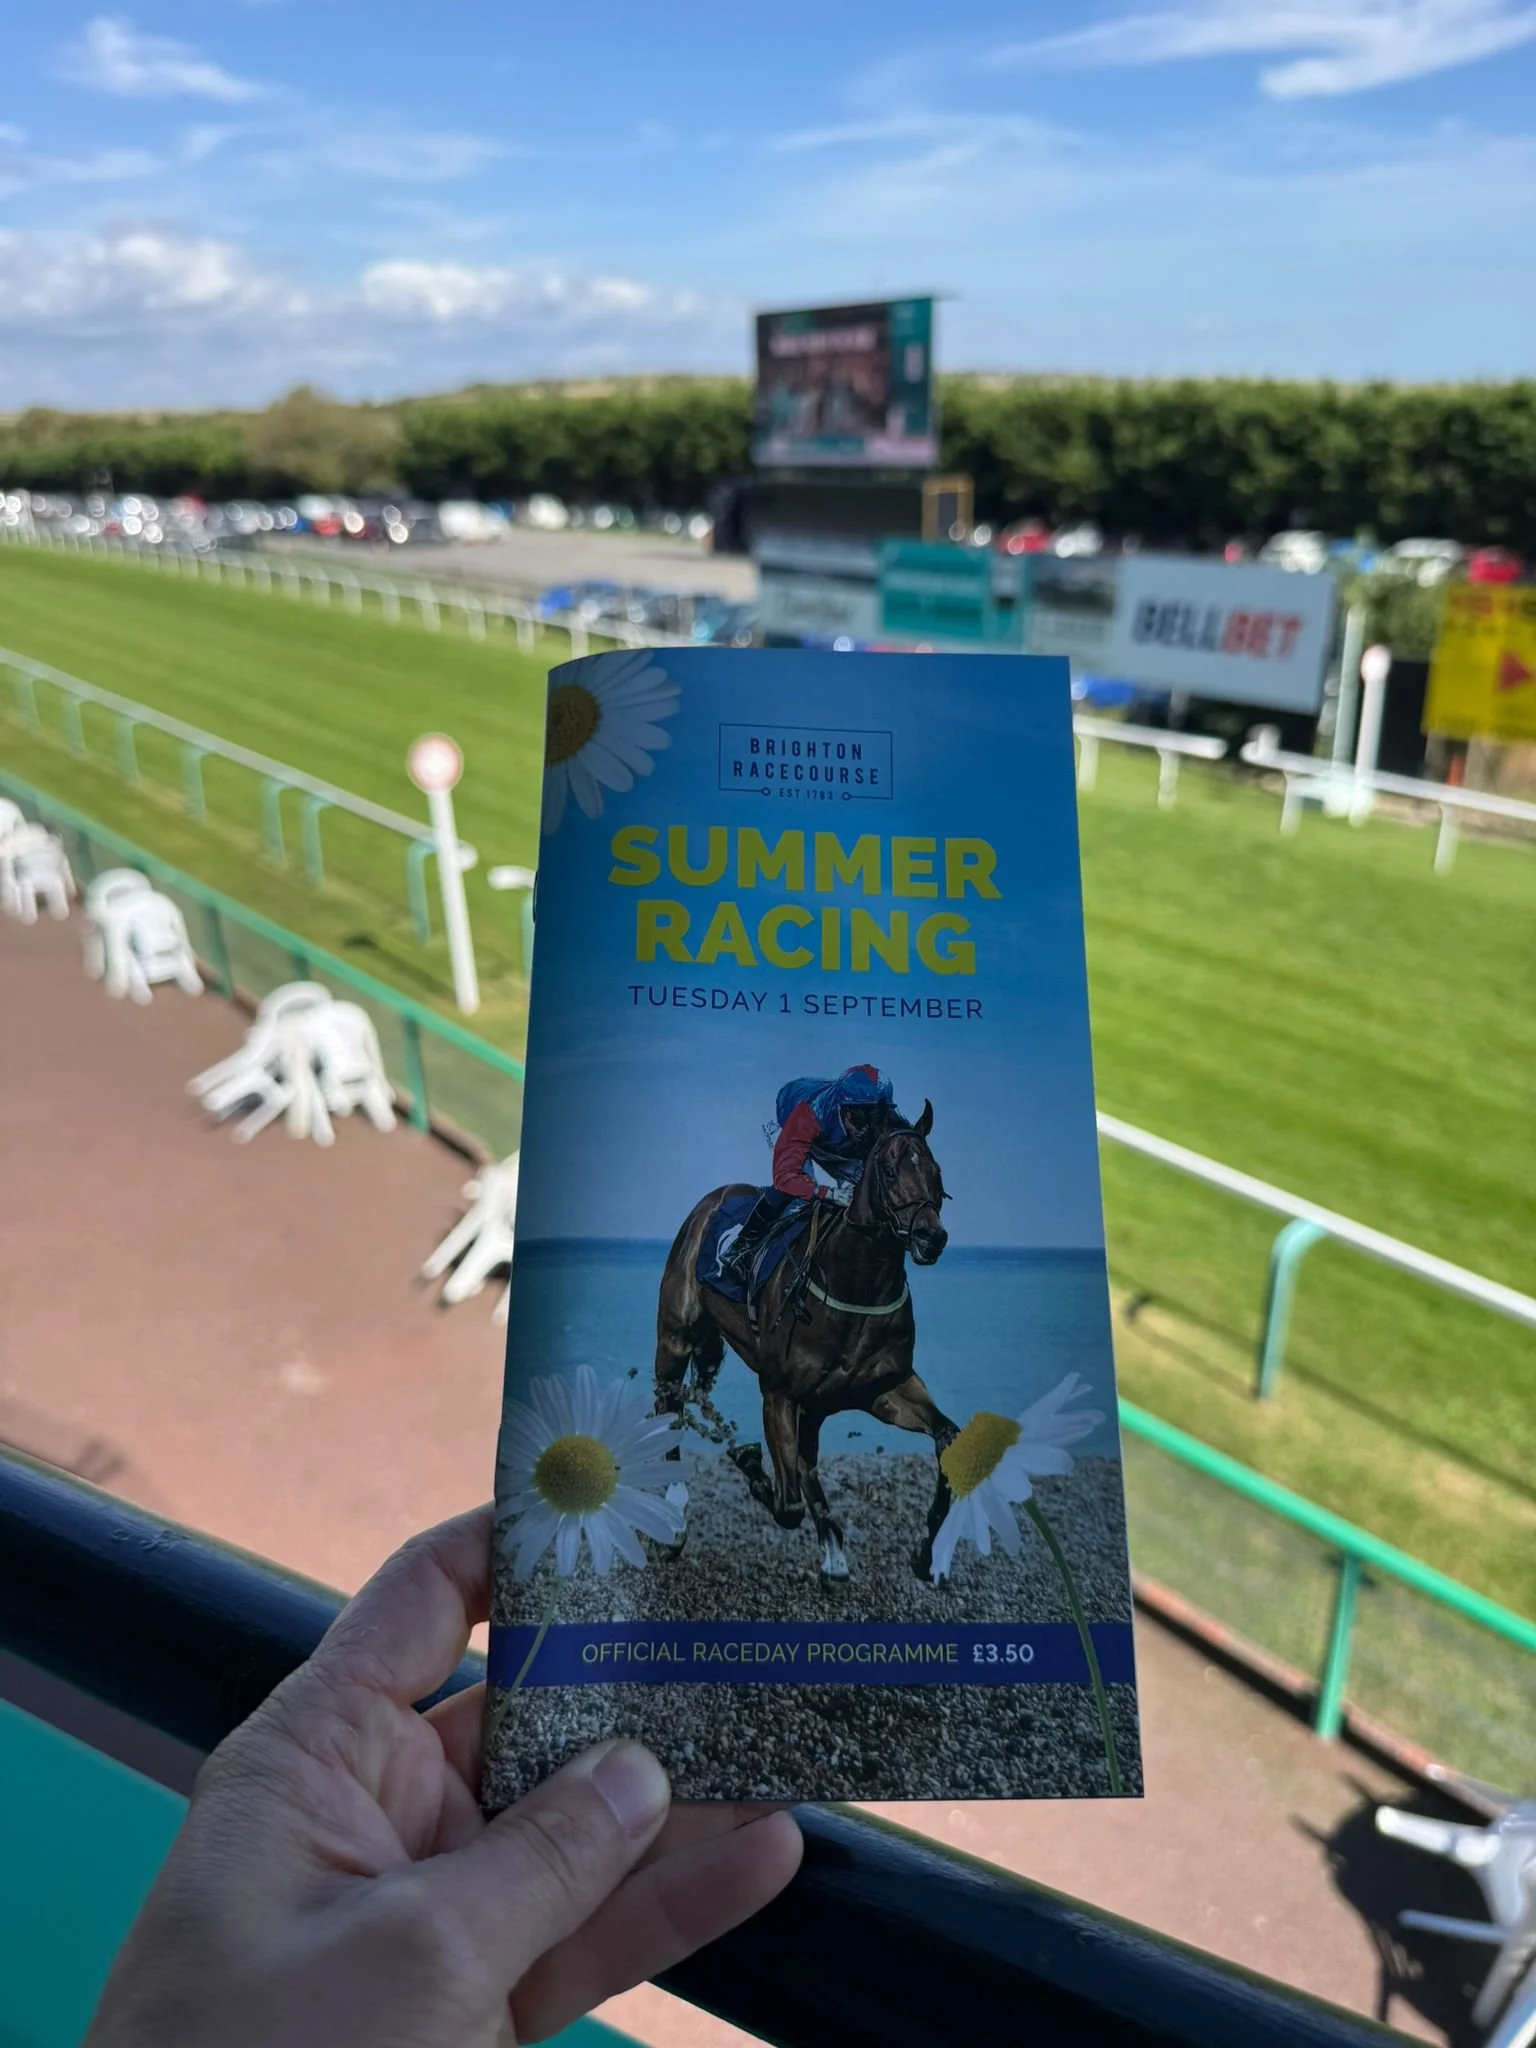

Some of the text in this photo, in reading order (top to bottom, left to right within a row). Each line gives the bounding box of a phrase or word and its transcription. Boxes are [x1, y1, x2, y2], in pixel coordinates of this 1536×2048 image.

[1133, 599, 1303, 663] BELLBET
[750, 738, 862, 760] BRIGHTON
[733, 761, 879, 785] RACECOURSE
[779, 788, 833, 801] EST 1783
[607, 825, 1003, 899] SUMMER
[635, 900, 977, 976] RACING
[628, 985, 984, 1020] TUESDAY 1 SEPTEMBER
[581, 1642, 1035, 1664] OFFICIAL RACEDAY PROGRAMME £3.50
